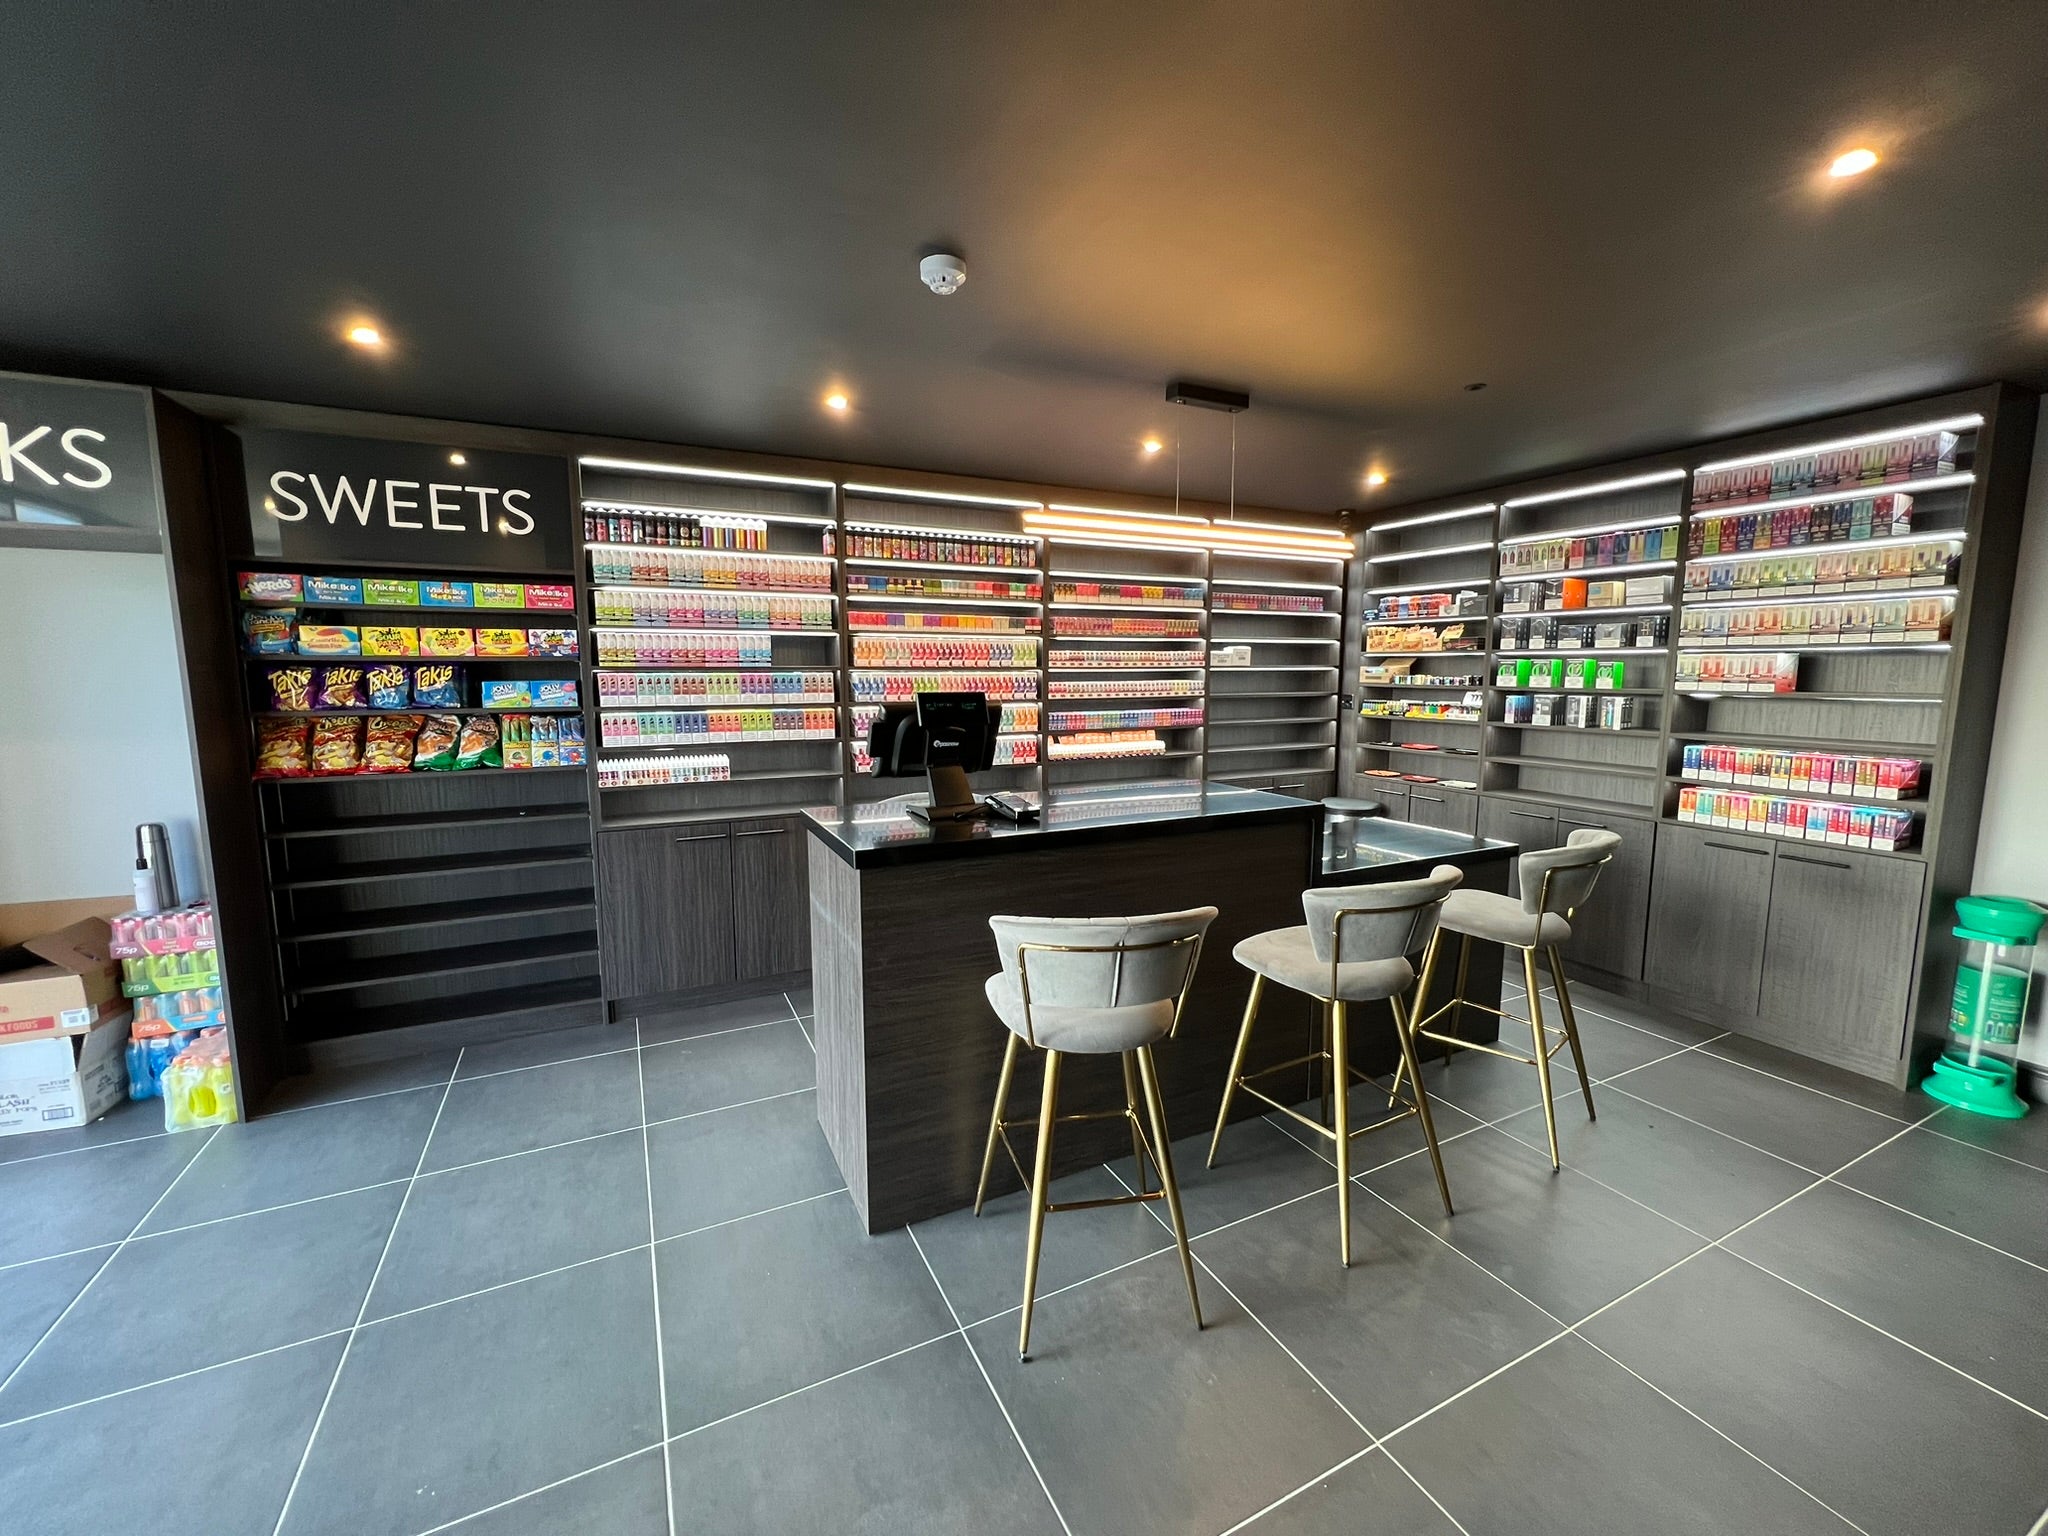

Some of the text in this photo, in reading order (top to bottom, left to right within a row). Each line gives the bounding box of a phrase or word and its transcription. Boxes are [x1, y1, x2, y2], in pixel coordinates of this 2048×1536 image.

[268, 470, 535, 536] SWEETS
[115, 946, 138, 955] 75p
[127, 984, 149, 993] 75p
